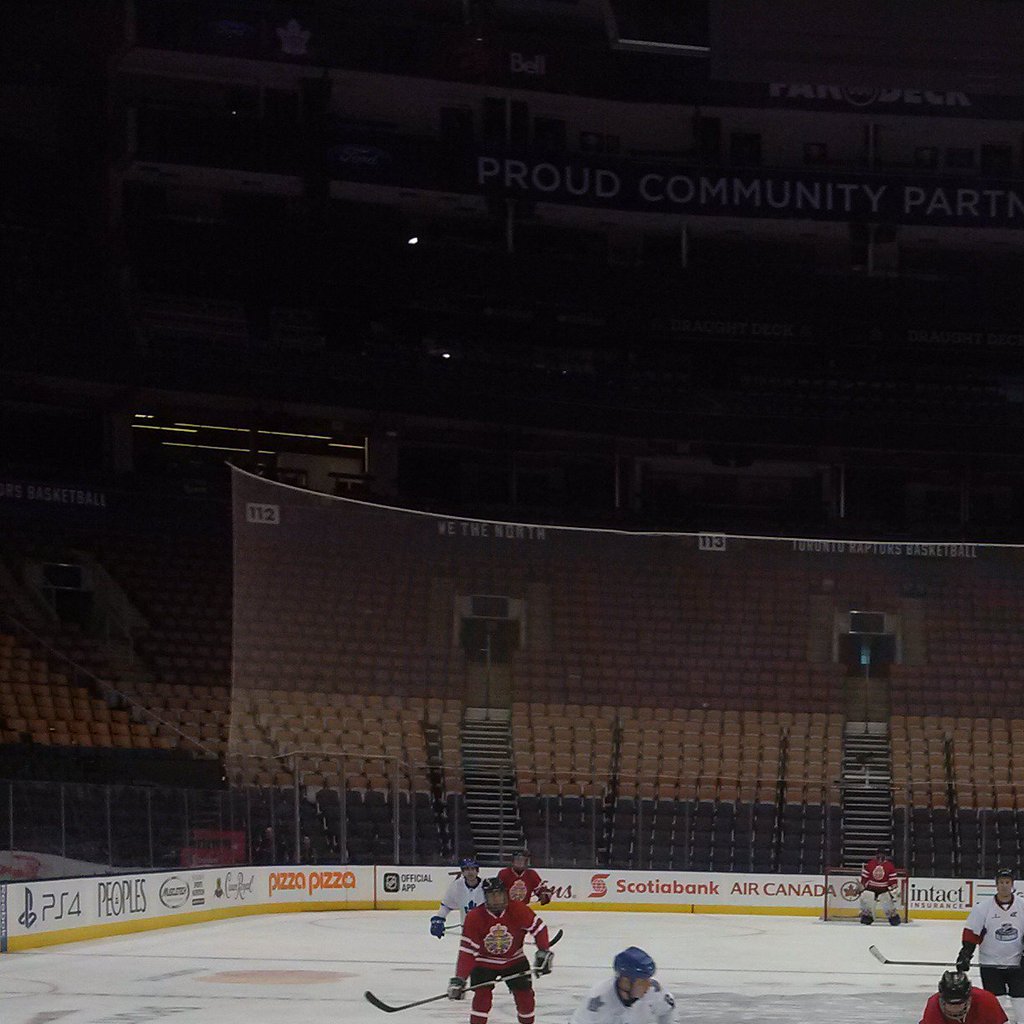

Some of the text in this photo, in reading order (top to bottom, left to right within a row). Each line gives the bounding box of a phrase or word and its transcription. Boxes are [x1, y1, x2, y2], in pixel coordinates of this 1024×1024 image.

[511, 53, 545, 74] Bell
[477, 156, 620, 198] PROUD
[639, 173, 888, 213] COMMUNITY
[26, 485, 106, 508] BASKETBALL
[249, 506, 276, 521] 112
[439, 521, 545, 540] WE THE NORTH
[701, 535, 724, 548] 113
[793, 540, 977, 558] TORONTO RAPTORS BASKETBALL
[269, 872, 356, 896] pizza pizza
[401, 874, 433, 883] OFFICIAL
[401, 883, 416, 892] APP
[616, 879, 719, 895] Scotiabank
[98, 879, 147, 917] PEOPLES
[731, 882, 837, 898] AIR CANADA
[910, 883, 965, 903] intact
[42, 891, 81, 921] PS4
